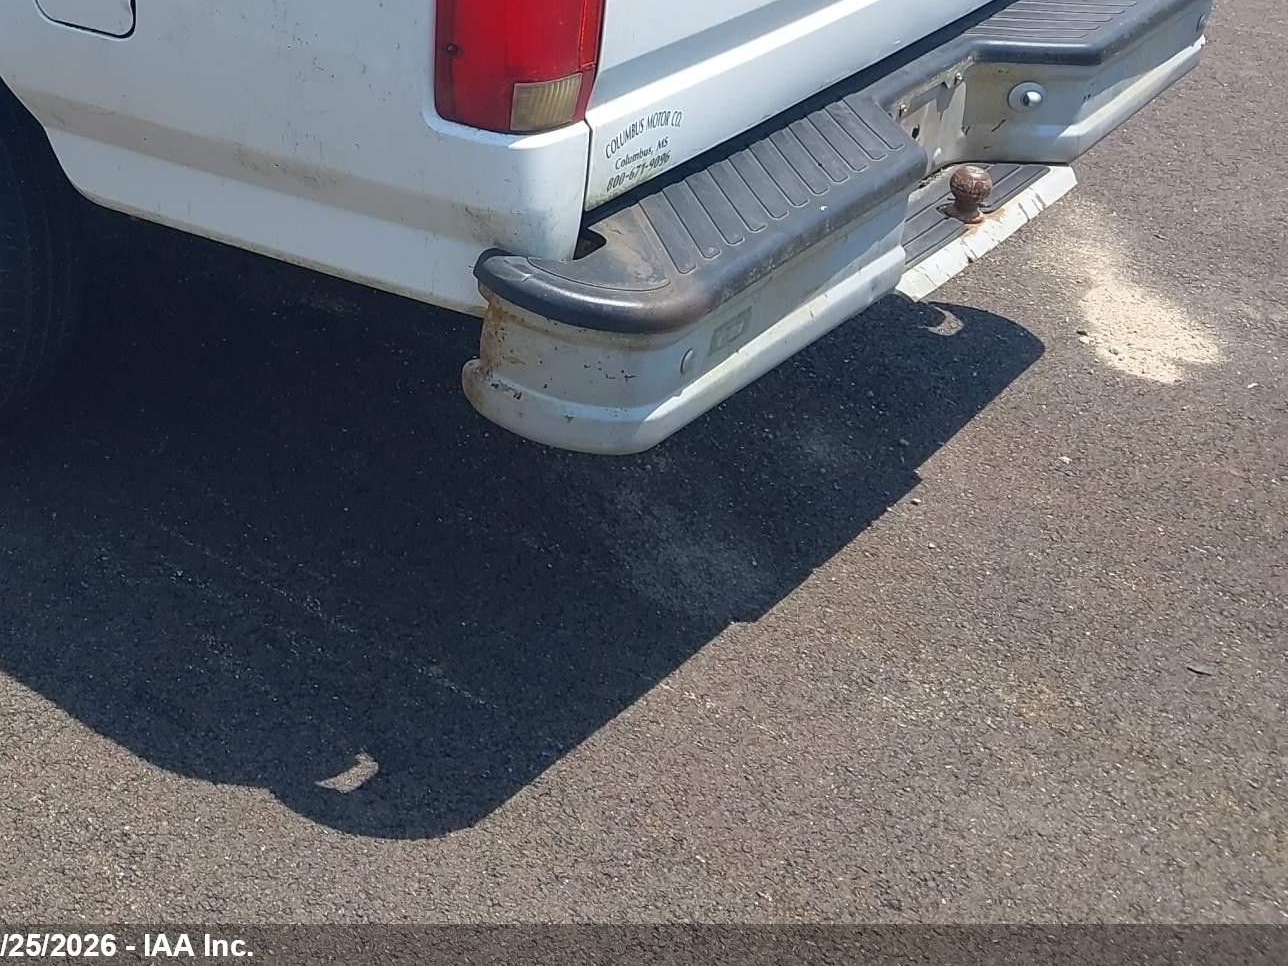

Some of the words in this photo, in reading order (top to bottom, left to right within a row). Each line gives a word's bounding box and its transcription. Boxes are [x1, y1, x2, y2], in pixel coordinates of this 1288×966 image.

[605, 117, 645, 159] COLUMBUS
[645, 110, 672, 131] MOTOR
[671, 110, 683, 128] CO.
[615, 147, 654, 170] Columbus,
[656, 136, 669, 151] MS
[607, 150, 672, 192] 800-671-9096
